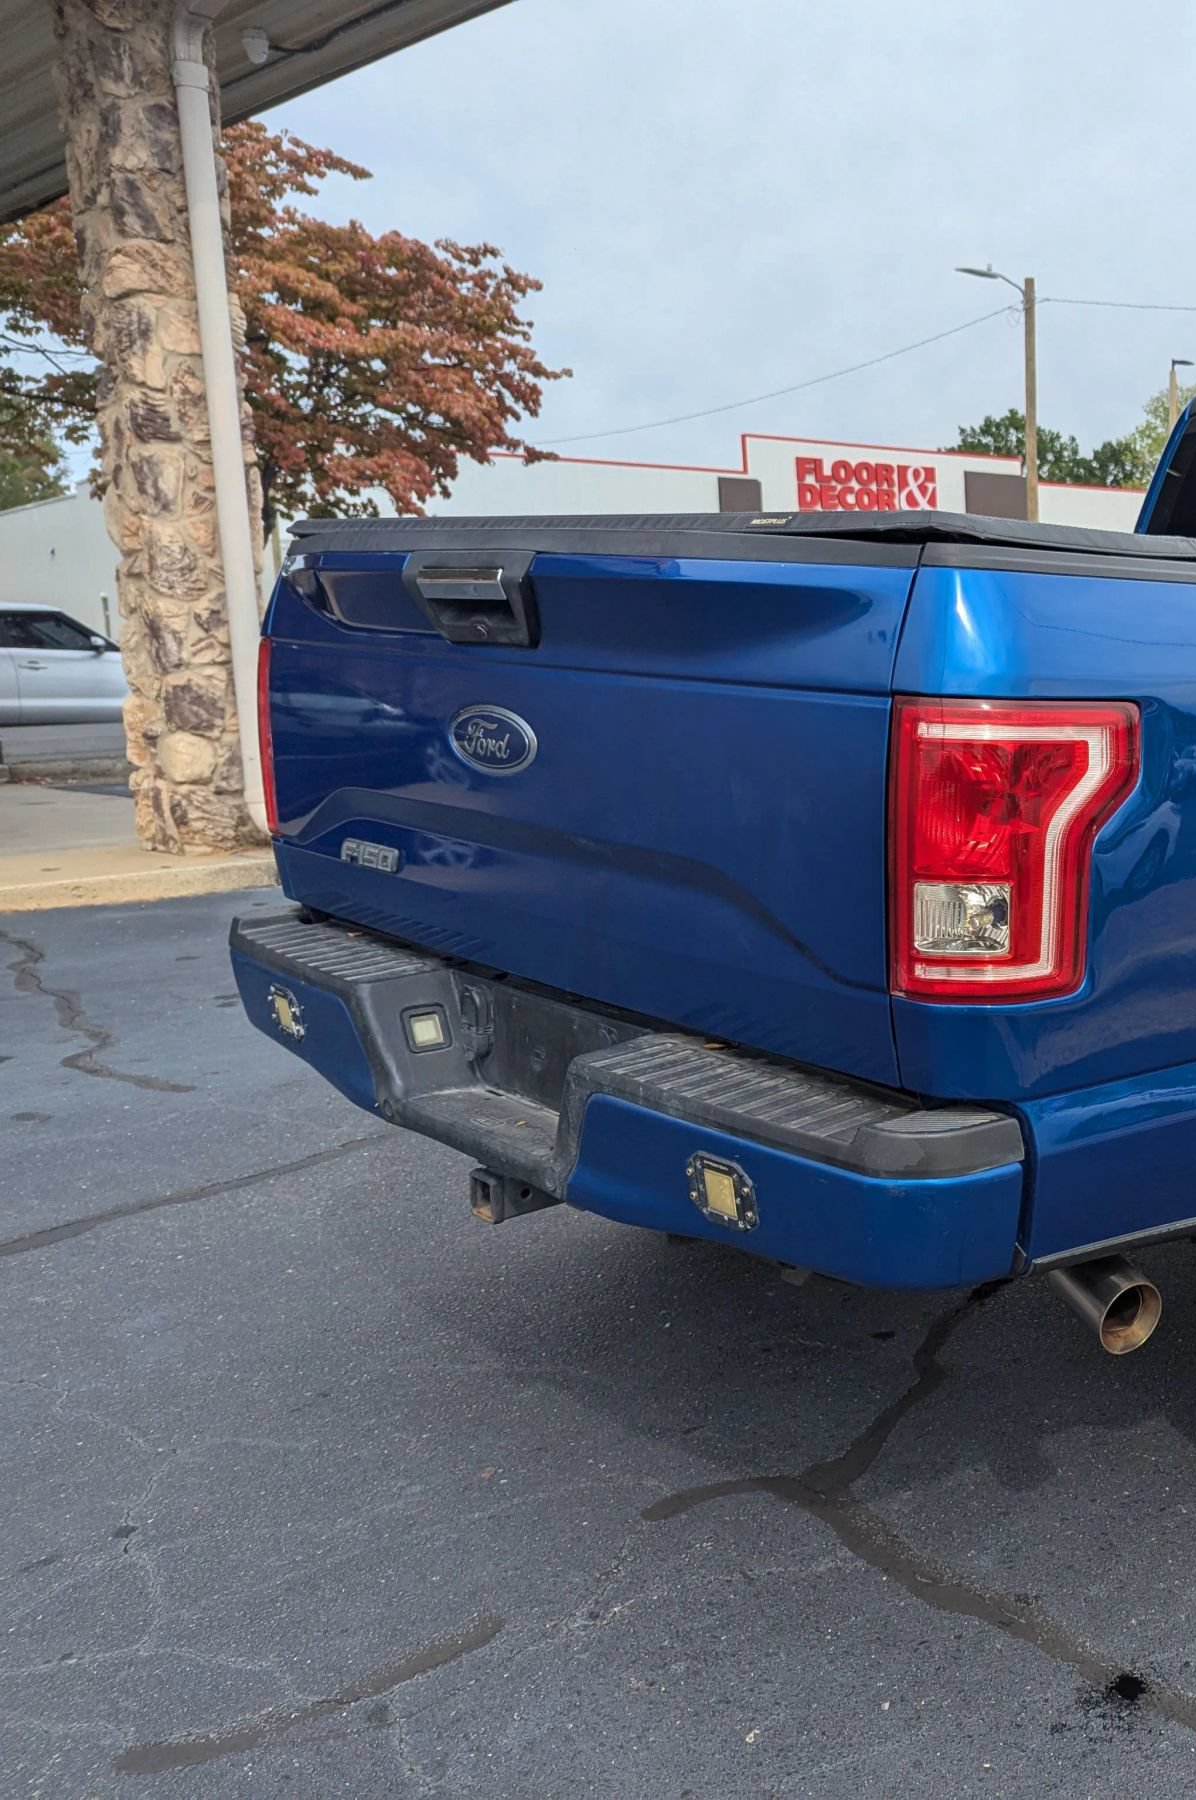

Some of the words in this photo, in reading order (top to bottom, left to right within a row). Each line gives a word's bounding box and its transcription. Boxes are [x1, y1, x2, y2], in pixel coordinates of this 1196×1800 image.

[796, 457, 896, 488] FLOOR
[899, 465, 938, 511] &
[798, 483, 897, 511] DECOR
[464, 718, 510, 760] Ford
